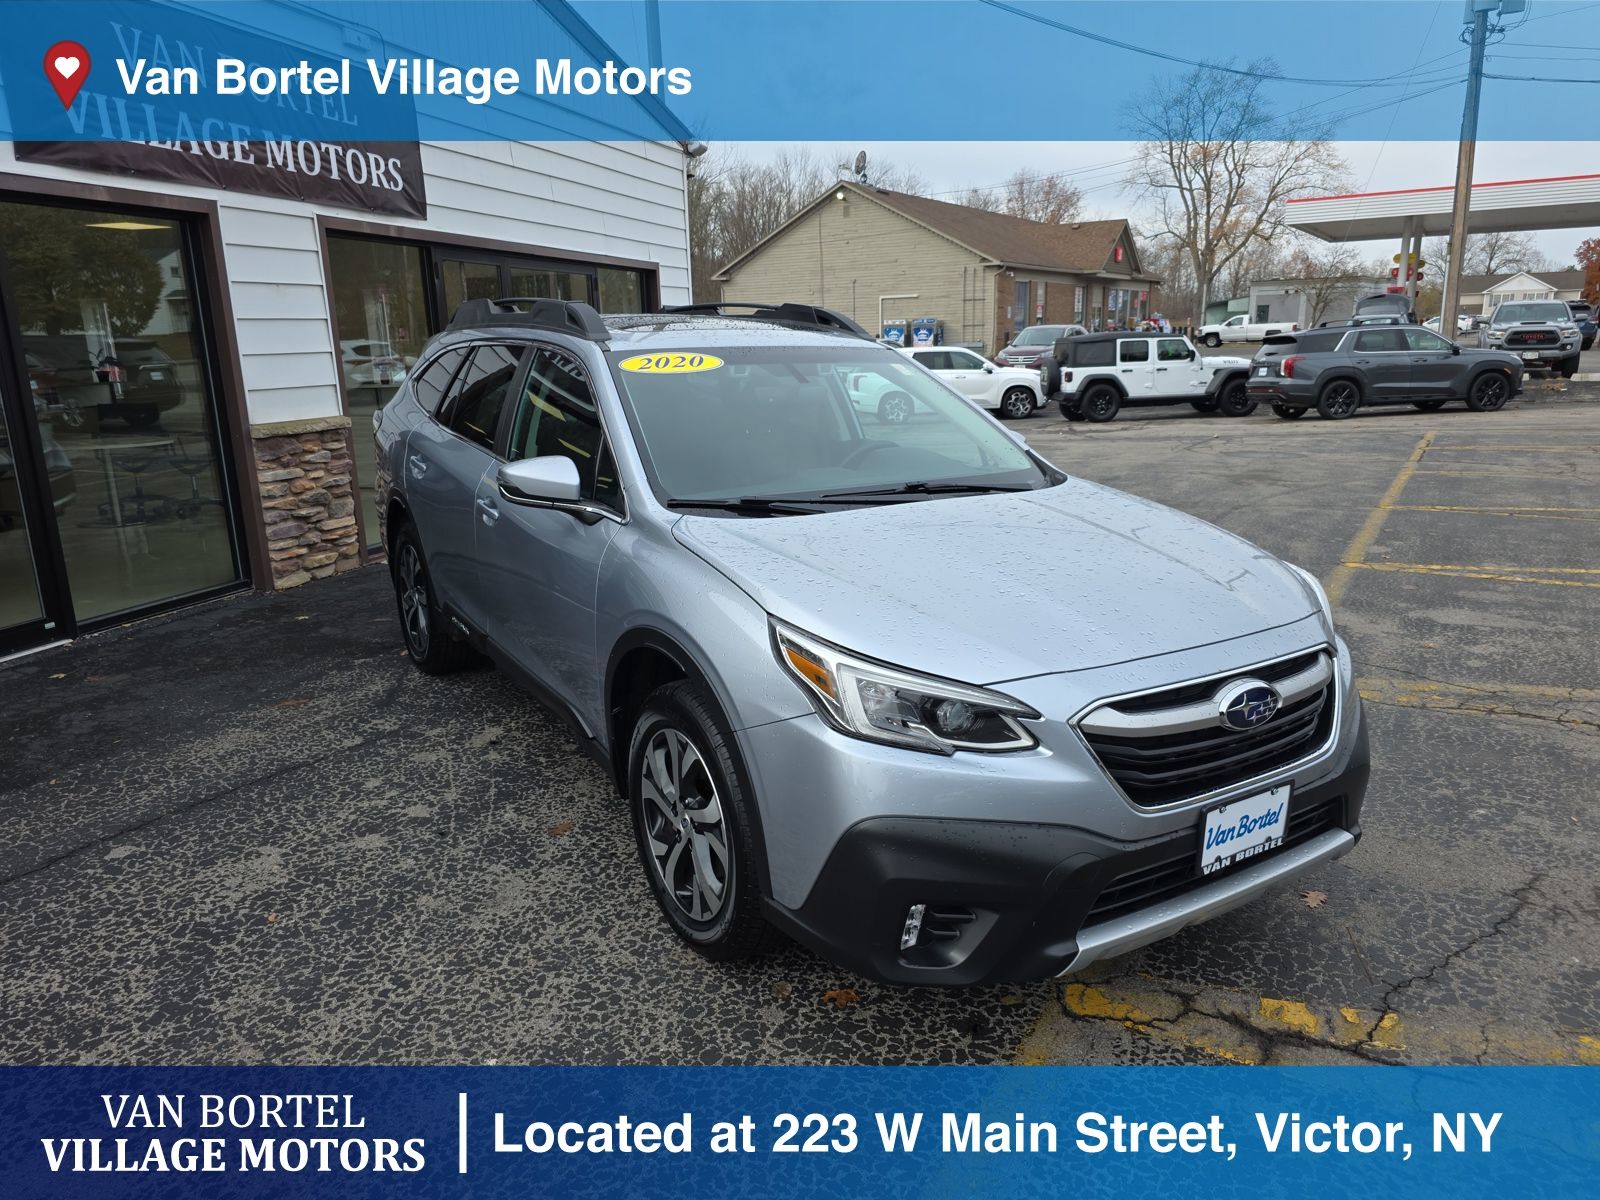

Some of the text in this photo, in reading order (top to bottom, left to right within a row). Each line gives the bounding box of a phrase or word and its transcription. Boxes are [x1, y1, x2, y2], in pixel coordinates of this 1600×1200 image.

[109, 21, 208, 89] VAN
[63, 88, 405, 193] VILLAGE MOTORS
[637, 355, 705, 371] 2020
[1202, 837, 1284, 875] VAN BORTEL
